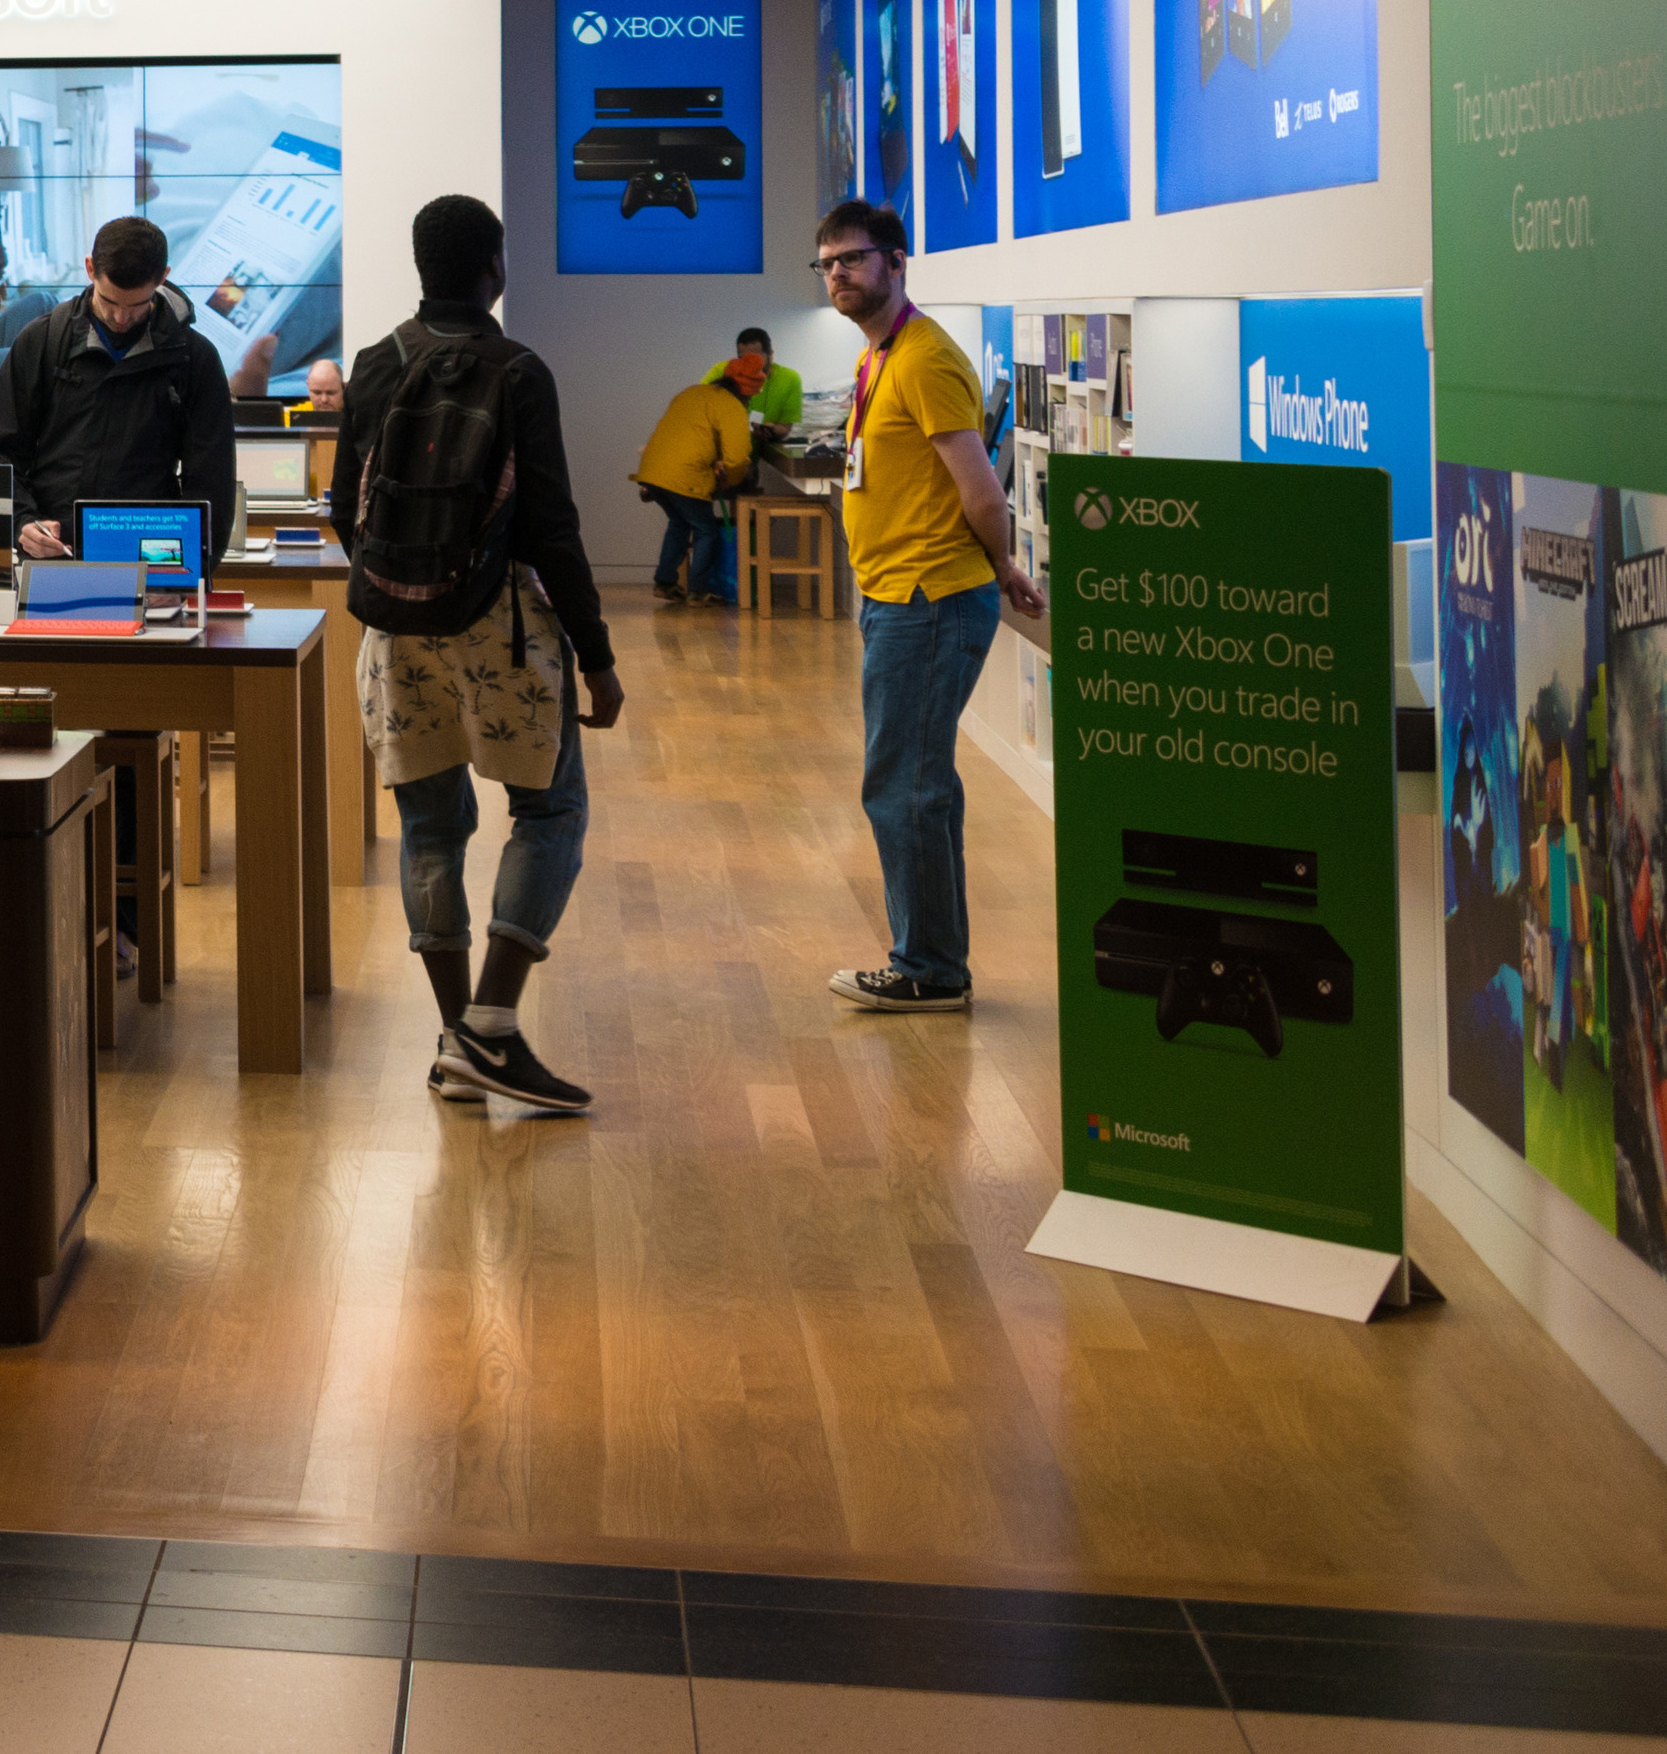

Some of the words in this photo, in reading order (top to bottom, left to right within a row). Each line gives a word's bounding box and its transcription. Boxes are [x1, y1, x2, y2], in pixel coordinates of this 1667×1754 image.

[613, 16, 685, 38] XBOX
[688, 16, 745, 37] ONE
[1274, 98, 1289, 139] Bell
[1453, 80, 1480, 144] The
[1484, 71, 1542, 157] biggest
[1511, 183, 1561, 251] Game
[1567, 195, 1595, 248] on.
[1267, 374, 1323, 445] Windows
[1324, 377, 1369, 453] Phone
[88, 523, 98, 531] off
[99, 523, 124, 531] Surface
[131, 523, 144, 531] and
[145, 523, 182, 531] accessories
[89, 514, 118, 522] Students
[119, 514, 132, 522] and
[133, 514, 161, 522] teachers
[162, 515, 174, 523] get
[174, 514, 189, 522] 10%
[1118, 496, 1200, 528] XBOX
[1455, 498, 1494, 594] ori
[1520, 525, 1596, 592] MINECRAFT
[1076, 567, 1129, 603] Get
[1139, 568, 1208, 608] $100
[1217, 580, 1329, 618] toward
[1077, 626, 1094, 651] a
[1104, 627, 1166, 656] new
[1175, 625, 1254, 664] Xbox
[1264, 633, 1334, 671] One
[1077, 669, 1160, 707] when
[1168, 684, 1226, 719] you
[1236, 685, 1321, 723] trade
[1331, 691, 1359, 726] in
[1078, 727, 1147, 761] your
[1155, 727, 1204, 763] old
[1214, 740, 1338, 778] console
[1114, 1122, 1191, 1151] Microsoft
